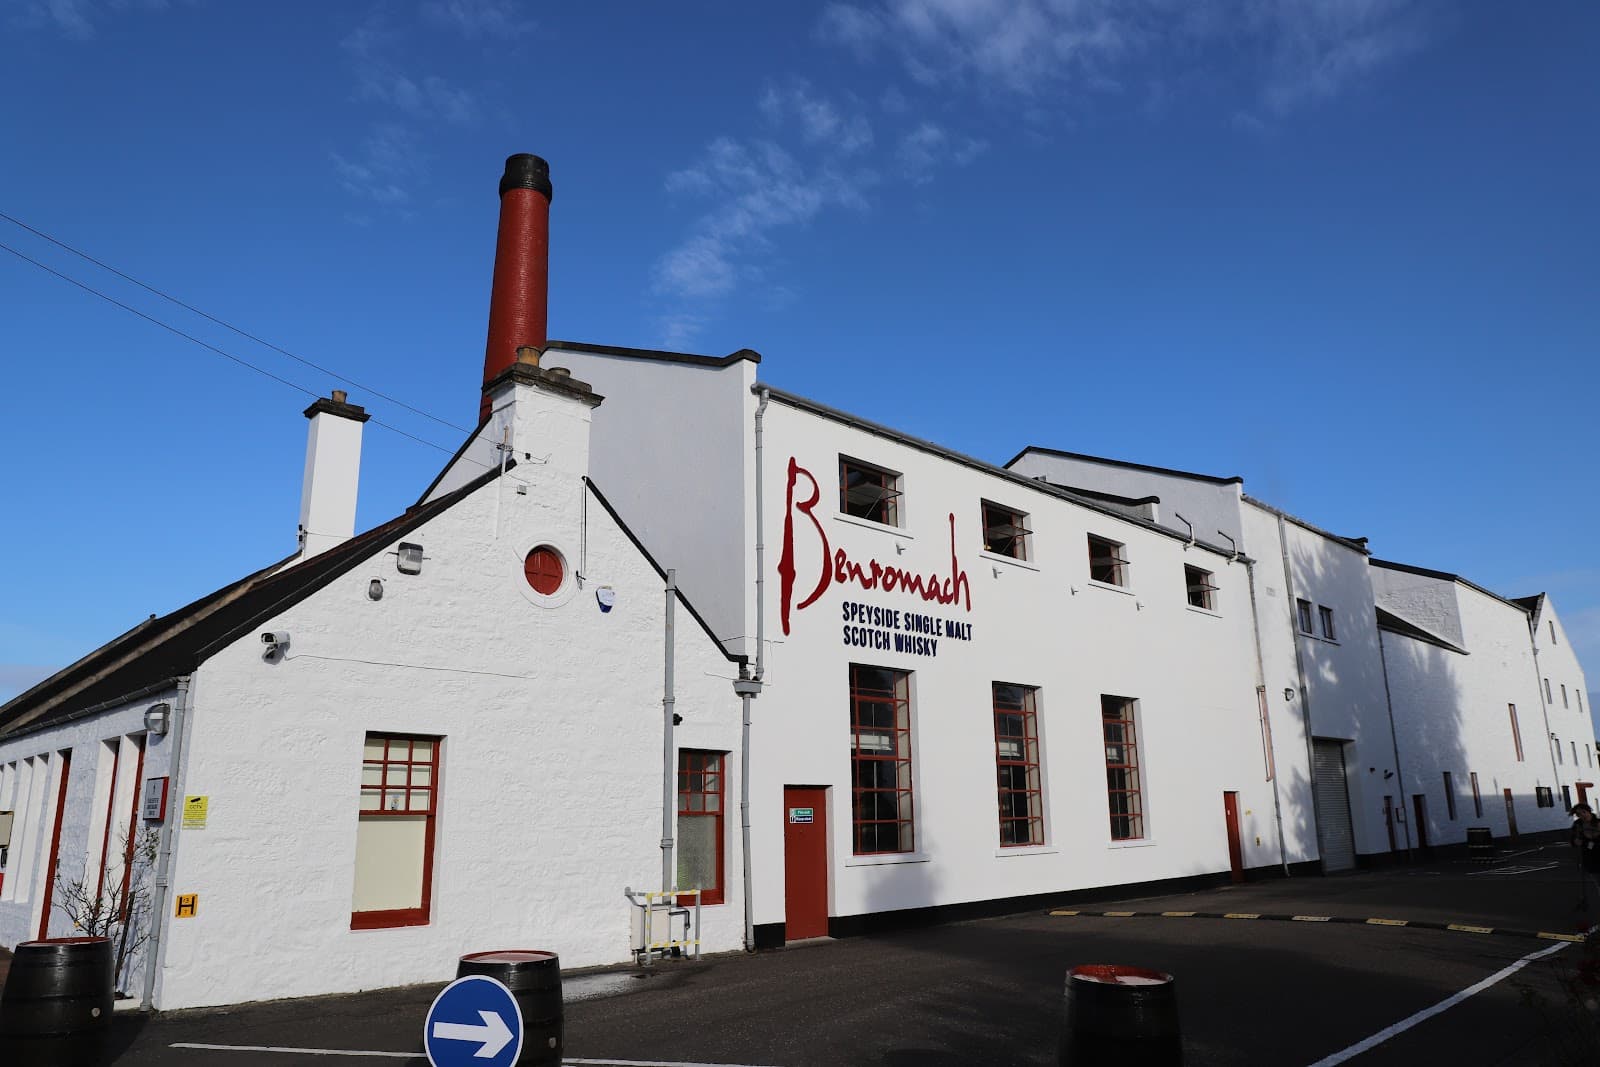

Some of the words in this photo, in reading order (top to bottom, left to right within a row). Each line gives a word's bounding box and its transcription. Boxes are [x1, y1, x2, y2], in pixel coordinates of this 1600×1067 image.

[778, 456, 971, 636] Benromach
[842, 601, 901, 629] SPEYSIDE
[904, 612, 943, 636] SINGLE
[945, 620, 973, 641] MALT
[843, 625, 891, 651] SCOTCH
[894, 633, 938, 657] WHISKY
[178, 896, 195, 916] H
